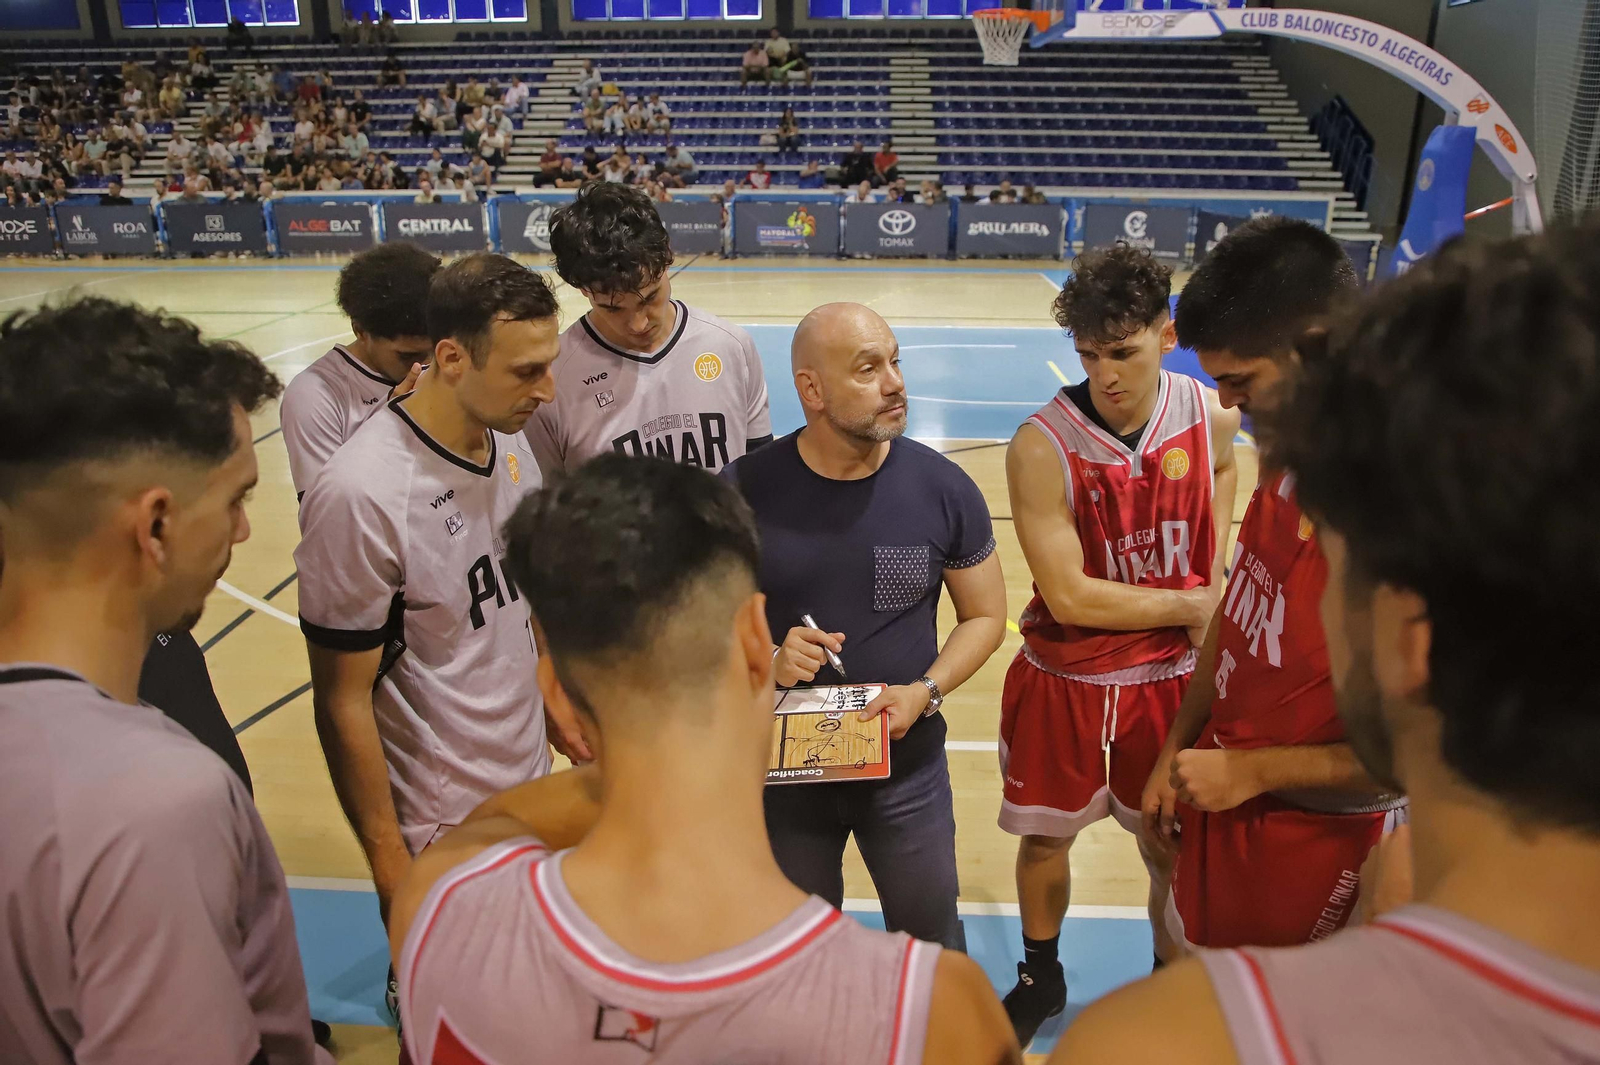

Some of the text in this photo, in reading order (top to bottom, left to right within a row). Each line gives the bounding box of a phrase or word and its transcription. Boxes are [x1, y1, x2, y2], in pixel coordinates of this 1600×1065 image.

[1241, 13, 1453, 86] CLUB BALONCESTO ALGECIRAS
[113, 222, 147, 233] ROA
[397, 218, 474, 232] CENTRAL
[192, 232, 243, 242] ASESORES
[760, 229, 796, 237] MAYORAL
[879, 237, 914, 247] TOMAX
[583, 371, 608, 386] vive
[642, 413, 698, 439] COLEGIO EL
[430, 489, 455, 510] vive
[1328, 869, 1360, 906] PINAR
[1321, 907, 1344, 921] EL
